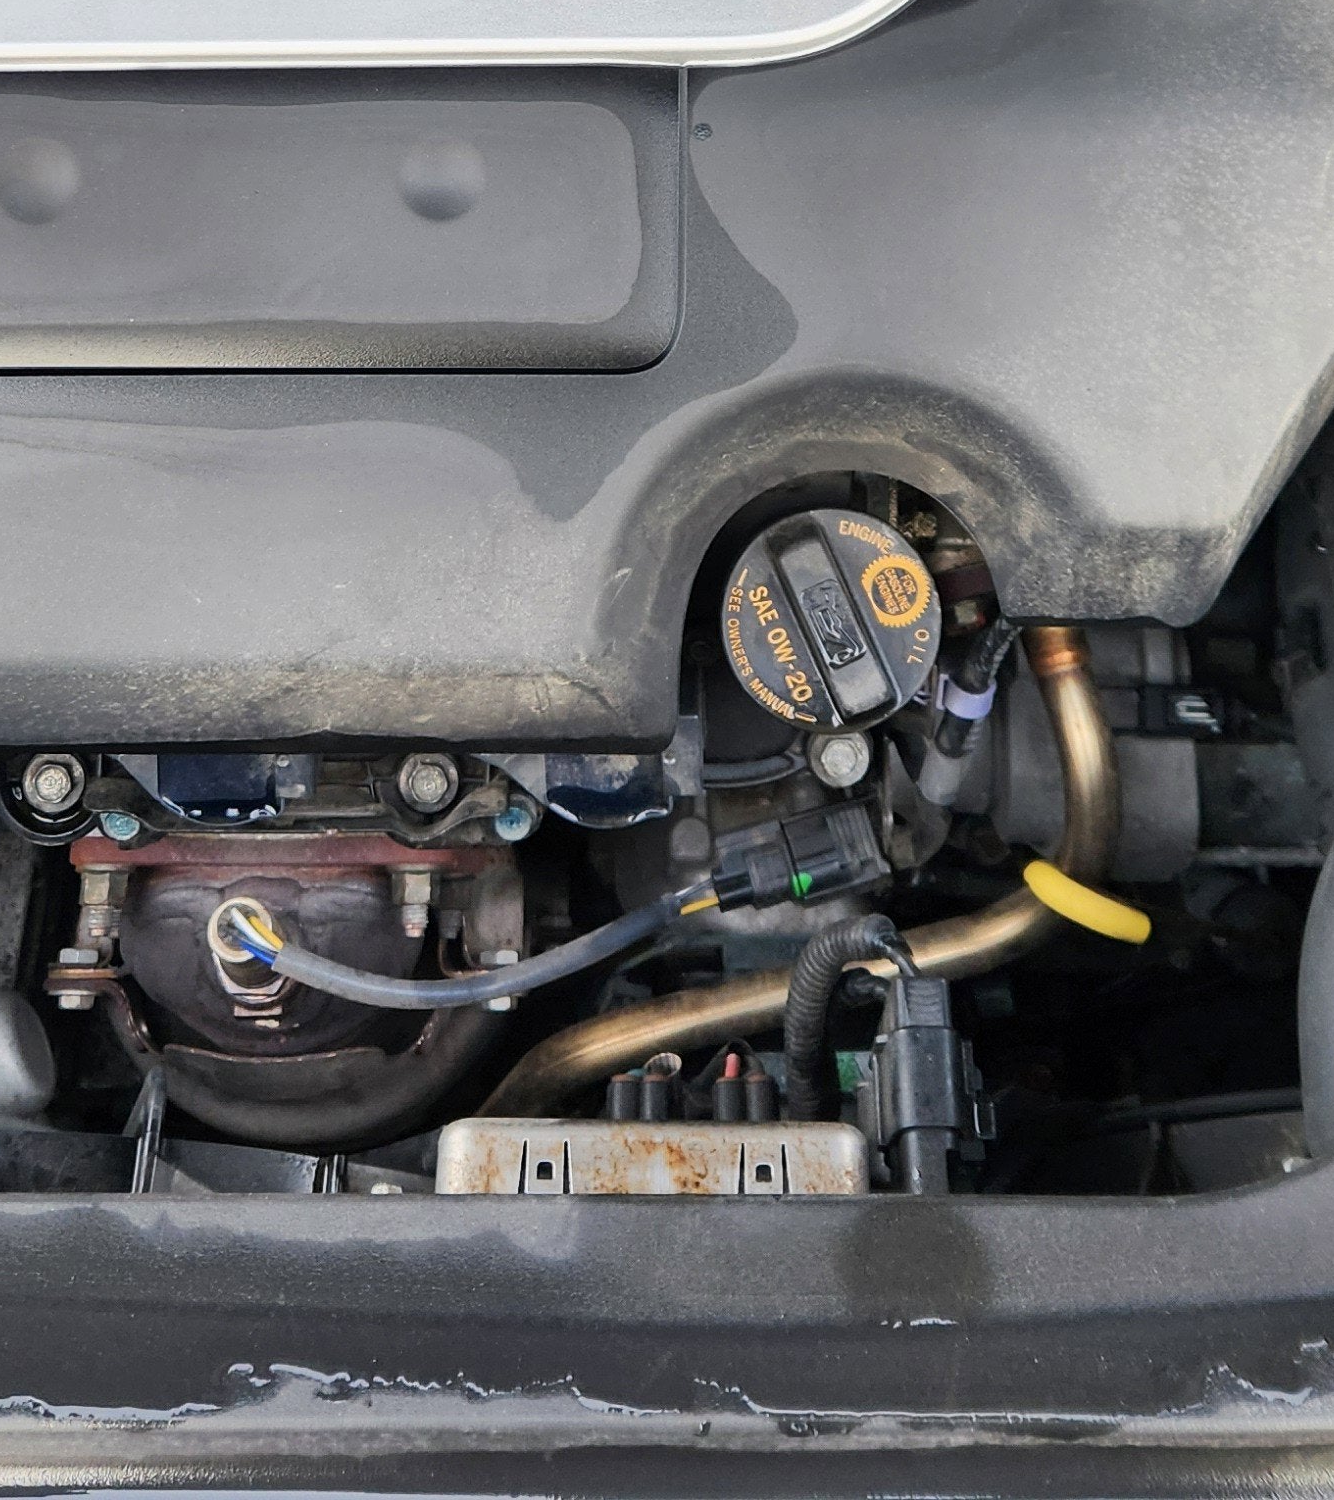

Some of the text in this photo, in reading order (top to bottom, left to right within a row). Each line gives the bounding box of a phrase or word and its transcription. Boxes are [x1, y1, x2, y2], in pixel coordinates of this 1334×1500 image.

[839, 519, 895, 554] ENGINE
[874, 574, 900, 614] ENGINES
[884, 568, 911, 612] GASOLINE
[899, 573, 917, 595] FOR
[749, 585, 780, 626] SAE
[727, 587, 796, 720] SEE OWNER'S MANUAL
[905, 628, 930, 665] OIL
